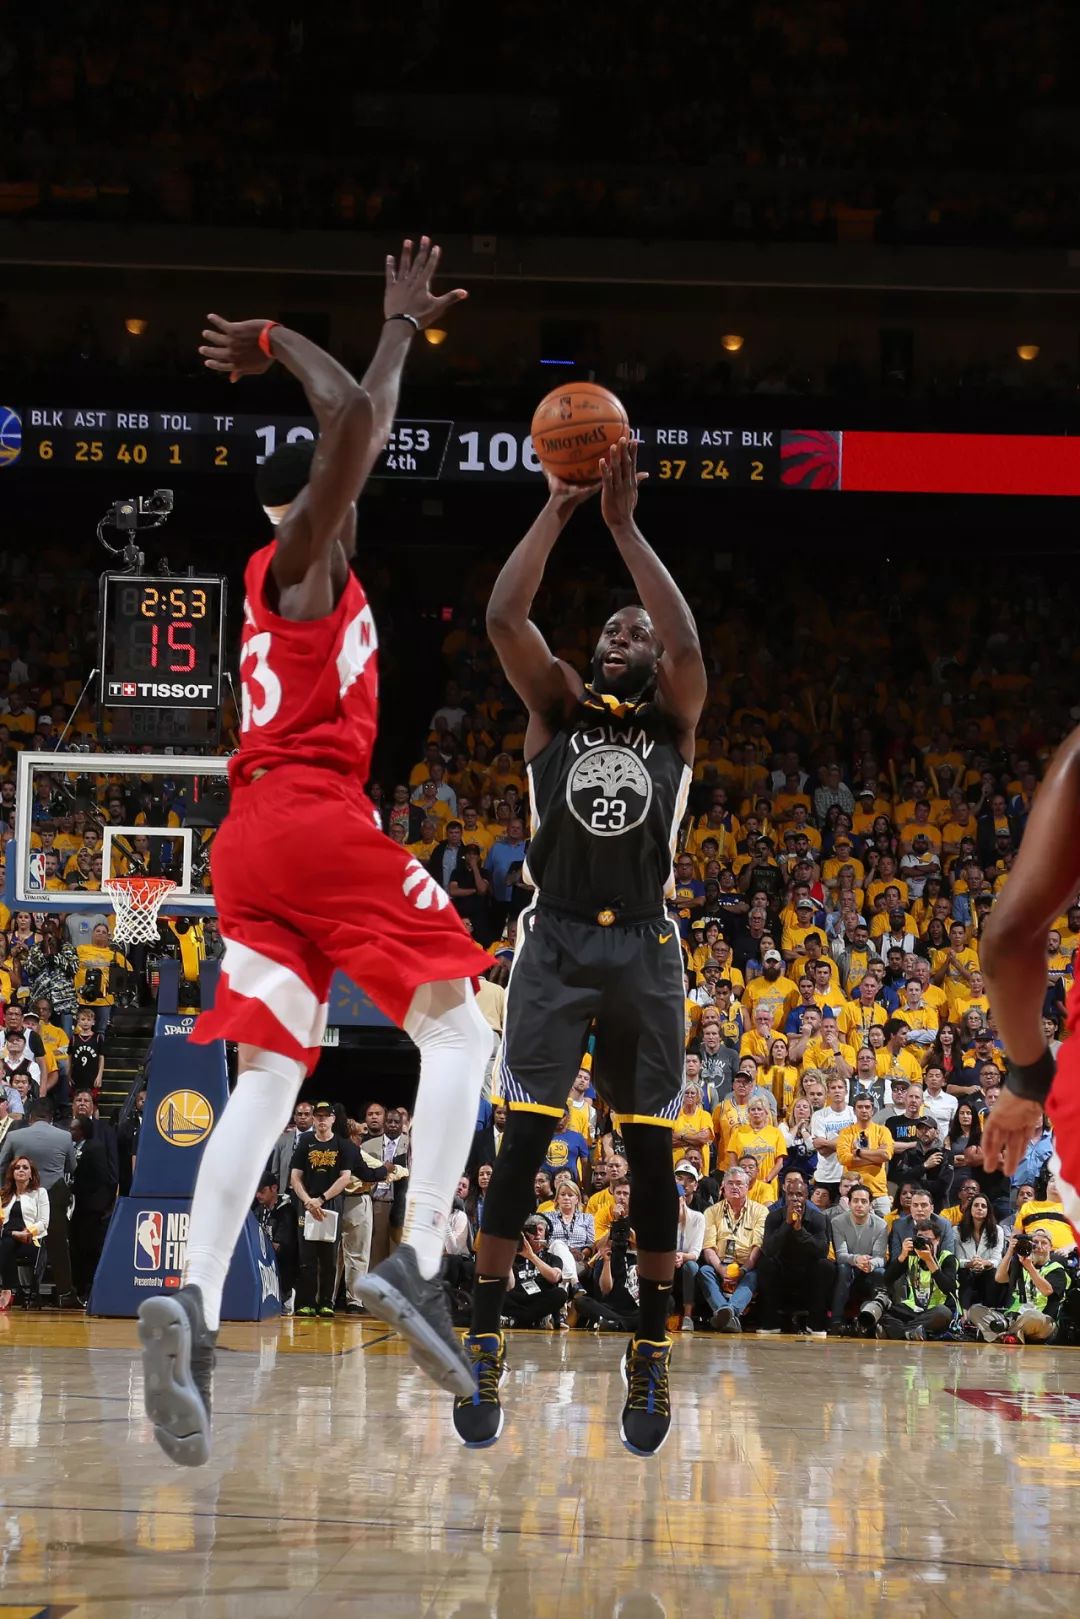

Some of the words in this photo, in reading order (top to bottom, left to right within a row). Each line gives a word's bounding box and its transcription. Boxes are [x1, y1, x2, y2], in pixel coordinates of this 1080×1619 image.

[31, 410, 63, 427] BLK
[74, 411, 107, 428] AST
[117, 413, 149, 429] REB
[160, 414, 192, 431] TOL
[213, 416, 234, 431] TF
[383, 428, 430, 451] :53
[656, 429, 689, 445] REB
[701, 430, 733, 446] AST
[742, 431, 773, 447] BLK
[39, 440, 53, 460] 6
[75, 441, 104, 462] 25
[117, 444, 147, 464] 40
[169, 444, 182, 465] 1
[214, 446, 228, 466] 2
[386, 453, 417, 470] 4th
[658, 460, 687, 480] 37
[701, 460, 729, 480] 24
[750, 461, 764, 481] 2
[141, 588, 206, 618] 2:53
[151, 621, 196, 672] 15
[138, 683, 213, 699] TISSOT
[570, 726, 655, 759] TOWN
[591, 798, 627, 830] 23
[164, 1024, 194, 1036] SPALD
[81, 1056, 88, 1067] 9
[167, 1212, 190, 1241] NB
[133, 1276, 157, 1288] Presented
[157, 1277, 164, 1288] by
